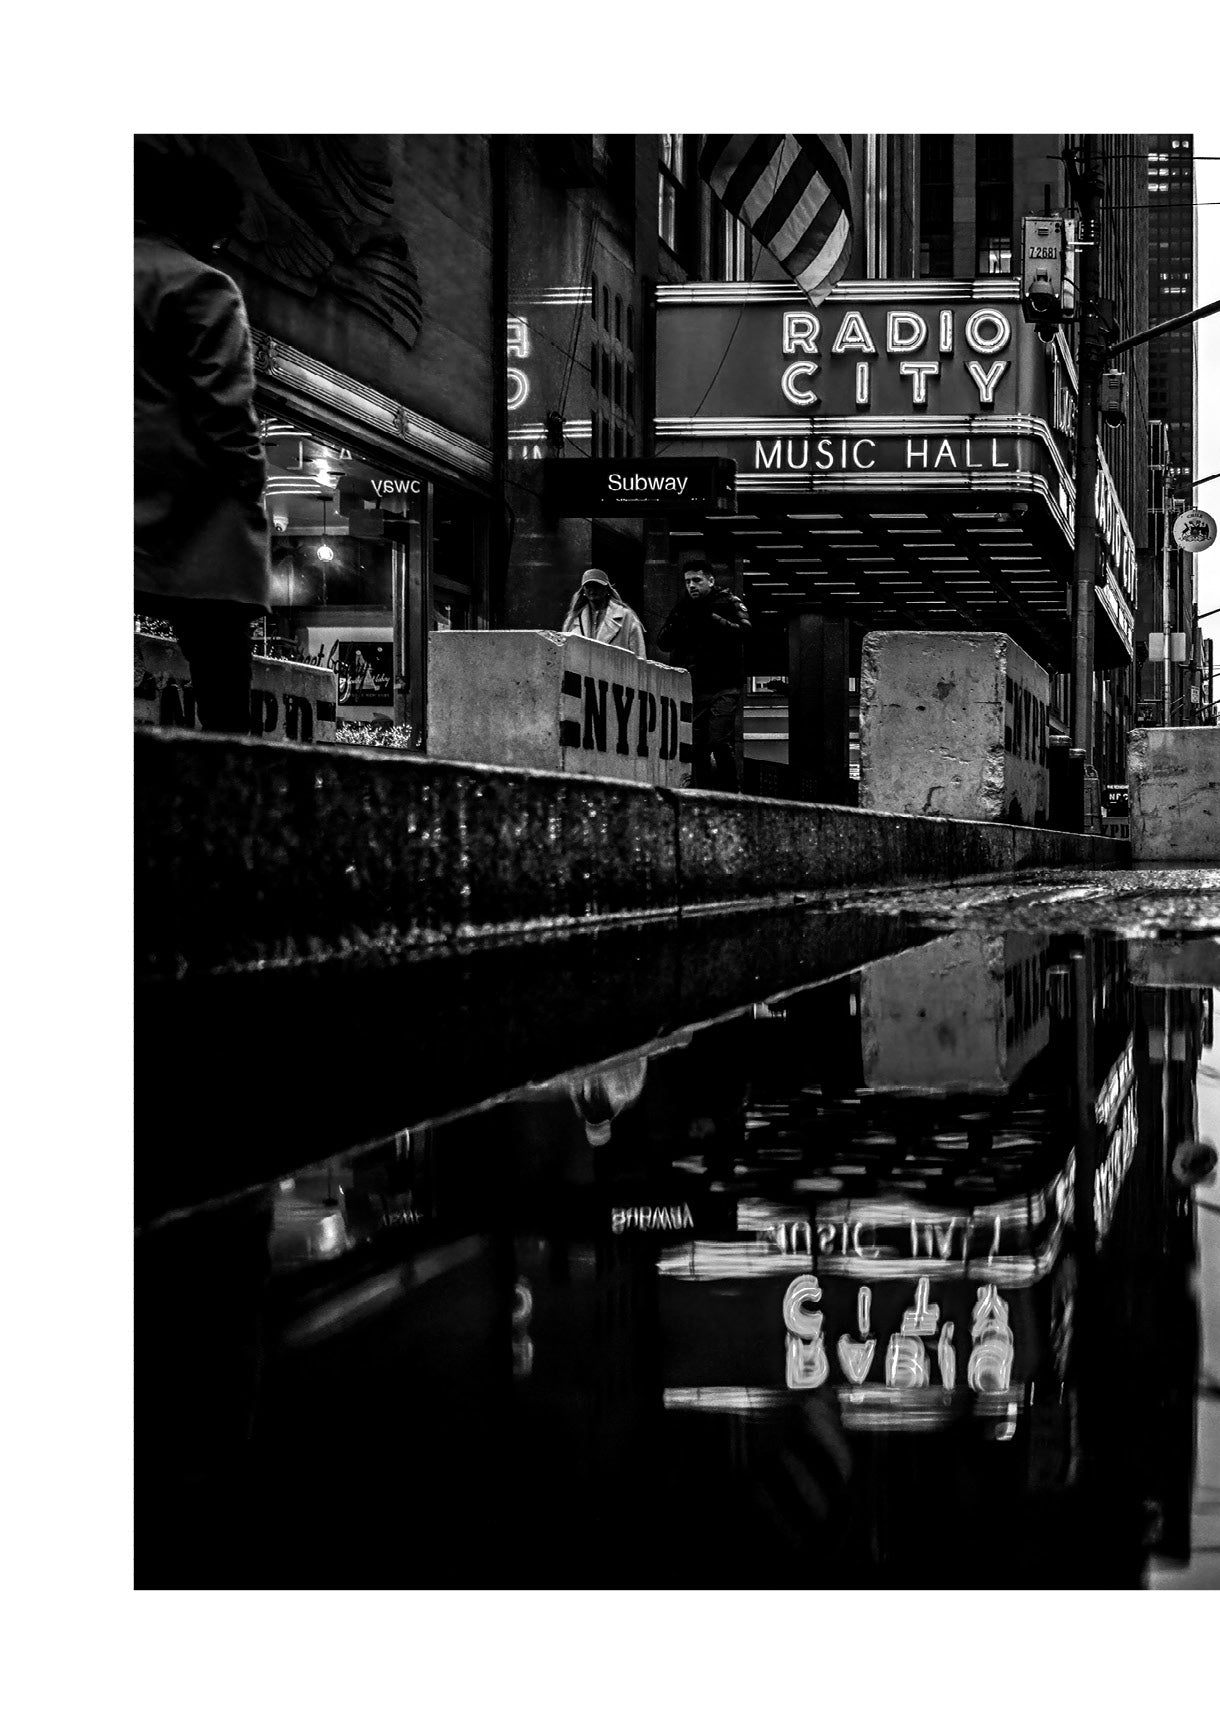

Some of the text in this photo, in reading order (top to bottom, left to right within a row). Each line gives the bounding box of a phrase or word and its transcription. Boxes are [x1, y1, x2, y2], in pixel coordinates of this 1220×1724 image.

[782, 308, 1011, 354] RADIO
[781, 360, 1009, 408] CITY
[754, 438, 1010, 470] MUSIC HALL
[606, 473, 689, 496] Subway
[583, 676, 679, 761] NYPD
